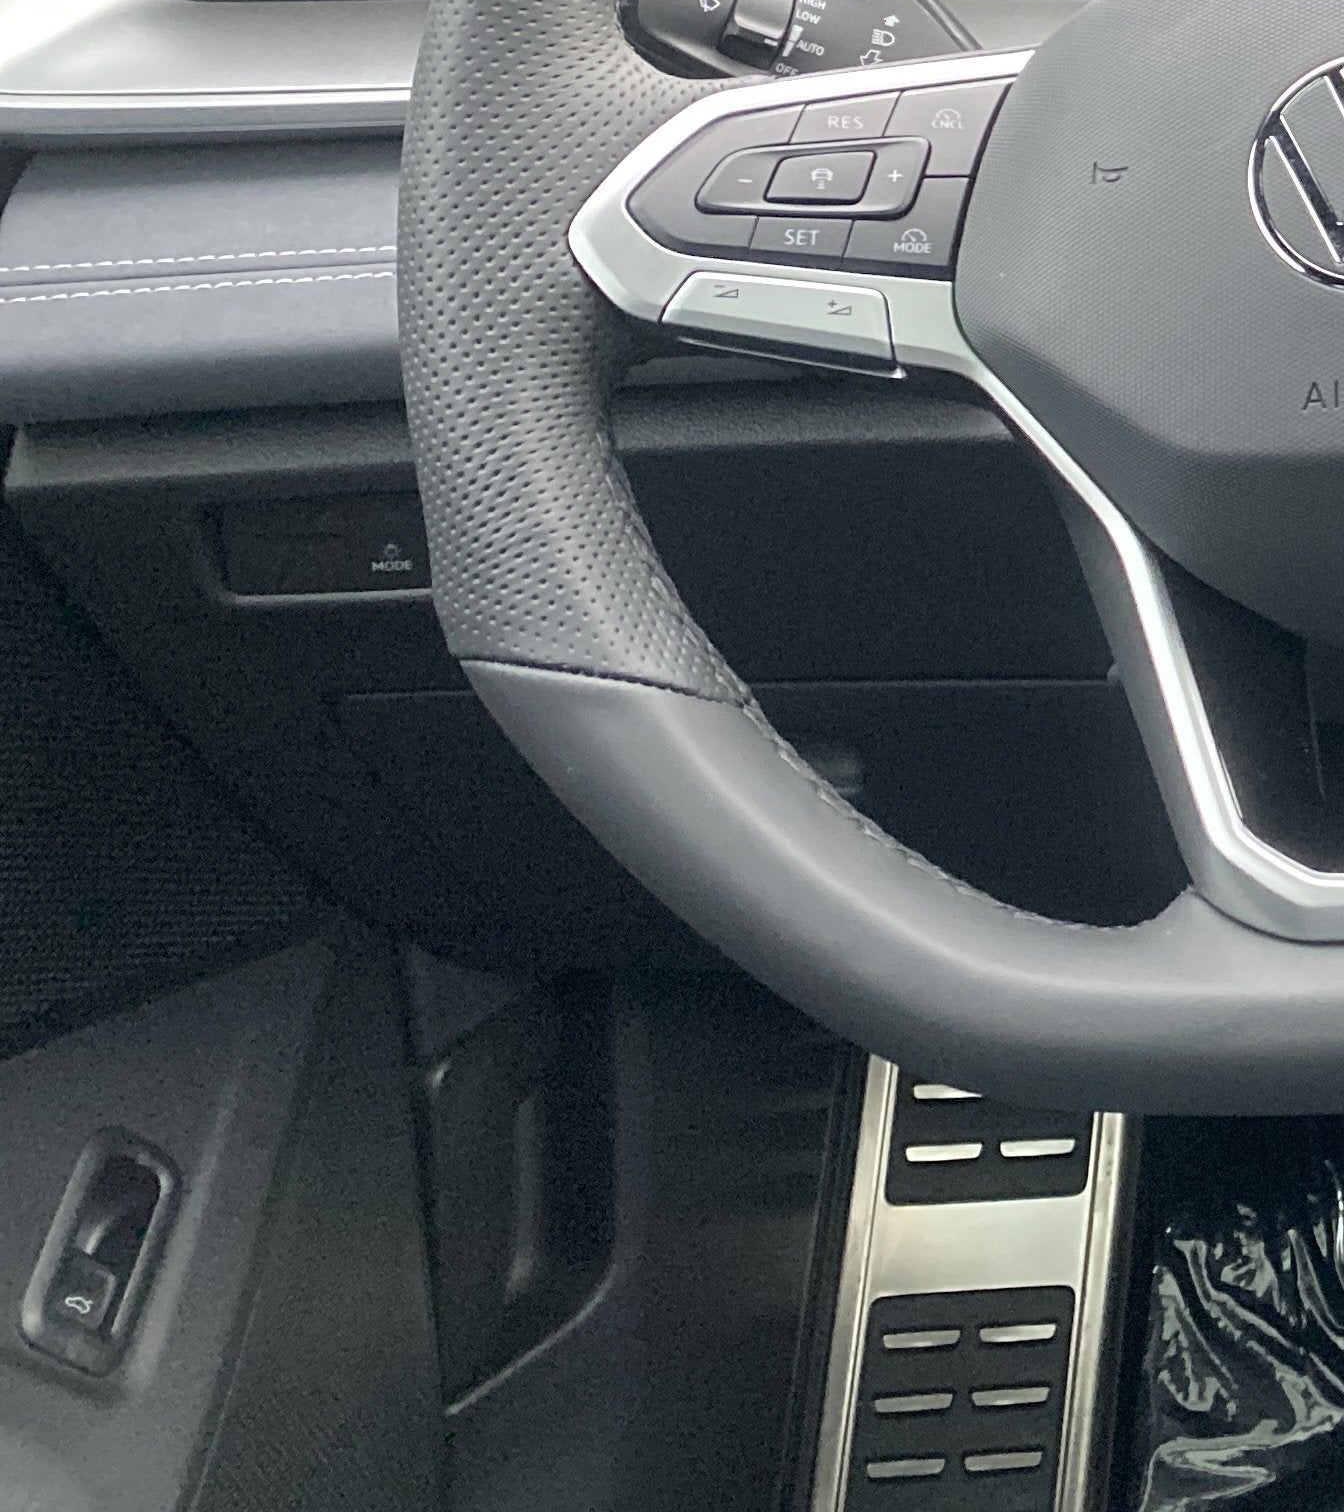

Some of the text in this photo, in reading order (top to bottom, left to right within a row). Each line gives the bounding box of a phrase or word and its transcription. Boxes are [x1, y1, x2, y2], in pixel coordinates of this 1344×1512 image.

[795, 9, 821, 25] LOW
[796, 40, 825, 56] AUTO
[775, 63, 799, 76] OFF
[827, 115, 864, 130] RES
[931, 119, 964, 130] CNCL
[783, 229, 820, 246] SET
[893, 242, 932, 254] MODE
[371, 559, 413, 573] MODE
